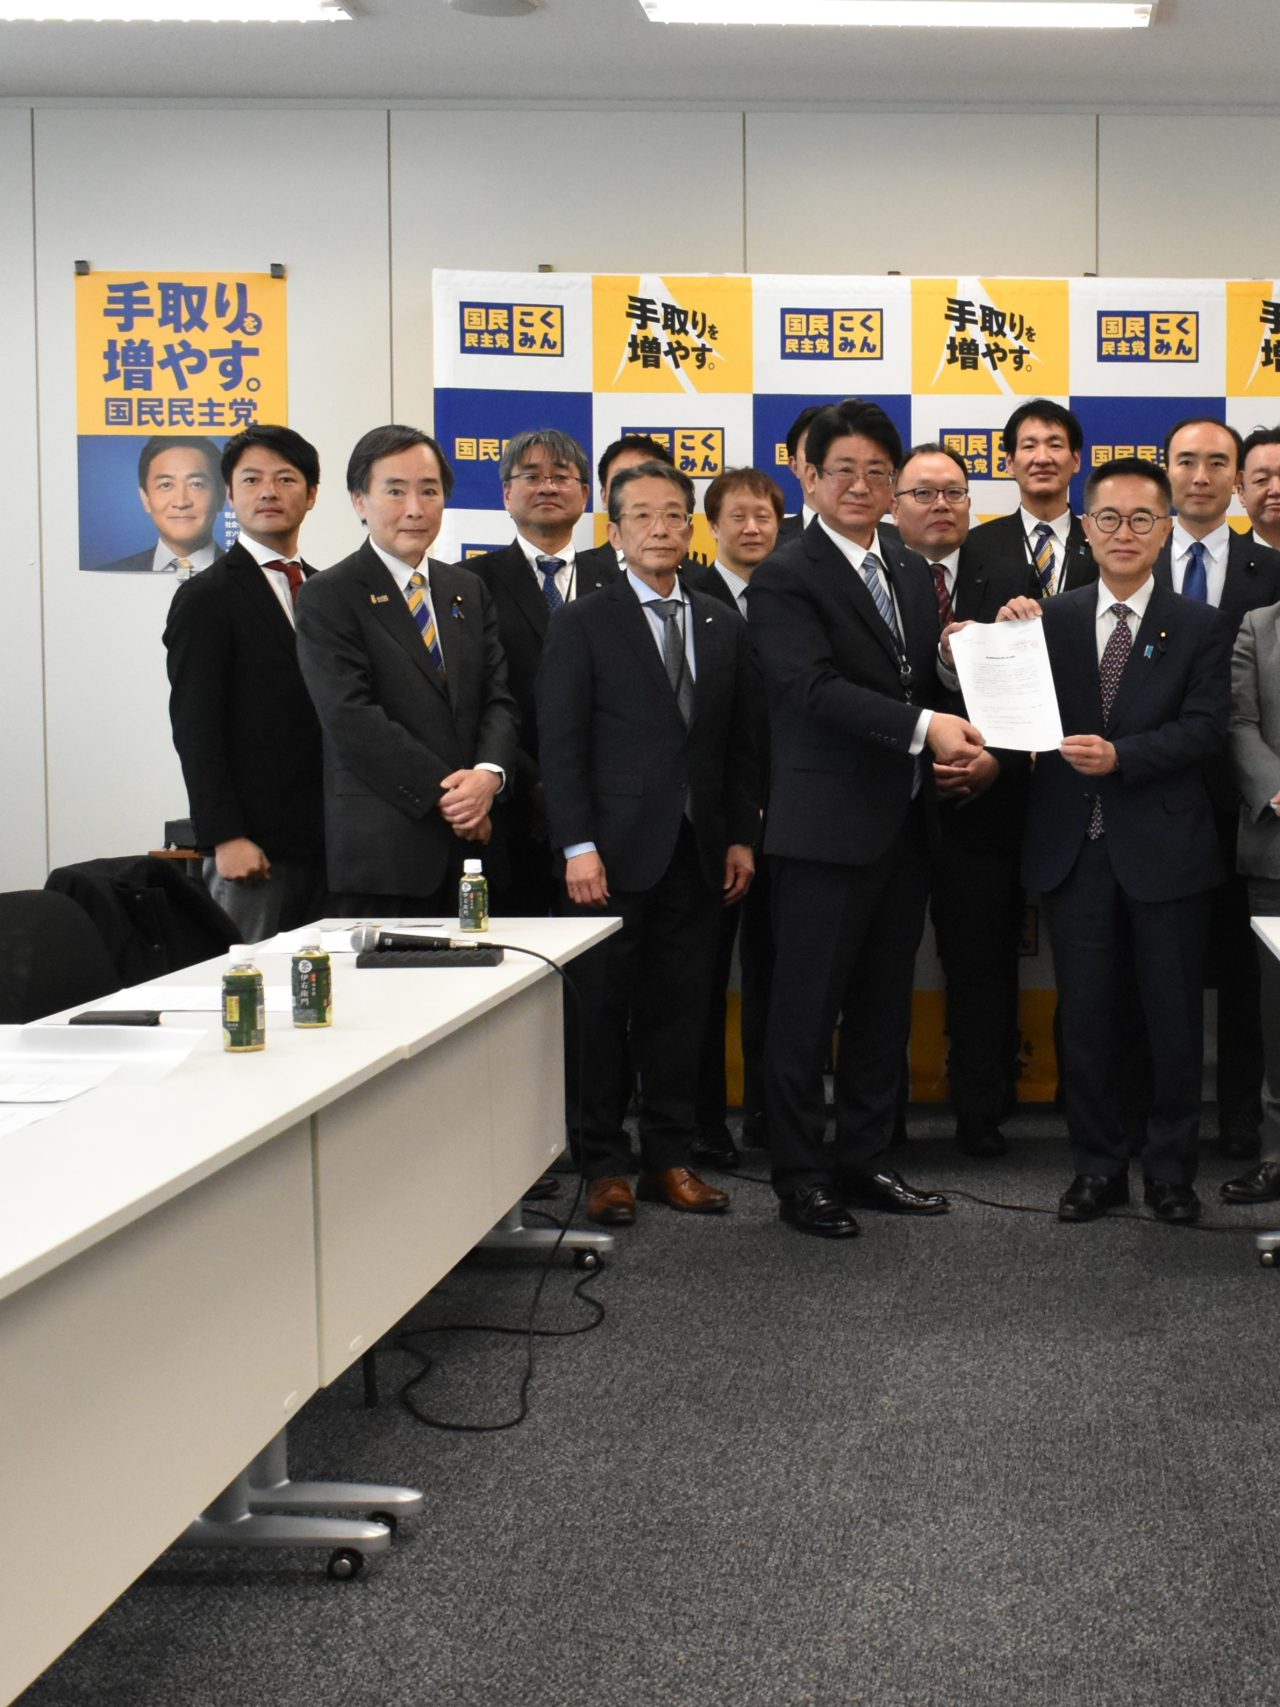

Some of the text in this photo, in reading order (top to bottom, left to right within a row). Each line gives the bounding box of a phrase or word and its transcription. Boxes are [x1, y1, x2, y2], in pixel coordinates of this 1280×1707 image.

[103, 281, 263, 336] 手取りを
[464, 308, 509, 331] 国民
[519, 311, 555, 329] こく
[626, 295, 719, 341] 手取りを
[784, 314, 829, 336] 国民
[839, 315, 875, 331] こく
[945, 297, 1036, 343] 手取りを
[1101, 316, 1145, 338] 国民
[1155, 317, 1190, 335] こく
[464, 332, 510, 349] 民主党
[518, 335, 557, 351] みん
[784, 338, 829, 354] 民主党
[838, 336, 877, 353] みん
[1101, 340, 1145, 356] 民主党
[1154, 338, 1193, 356] みん
[627, 335, 716, 371] 増やす。
[946, 336, 1033, 373] 増やす。
[102, 339, 261, 391] 増やす。
[104, 398, 258, 427] 国民民主党
[680, 433, 716, 451] こく
[679, 455, 718, 472] みん
[962, 458, 988, 473] 主党
